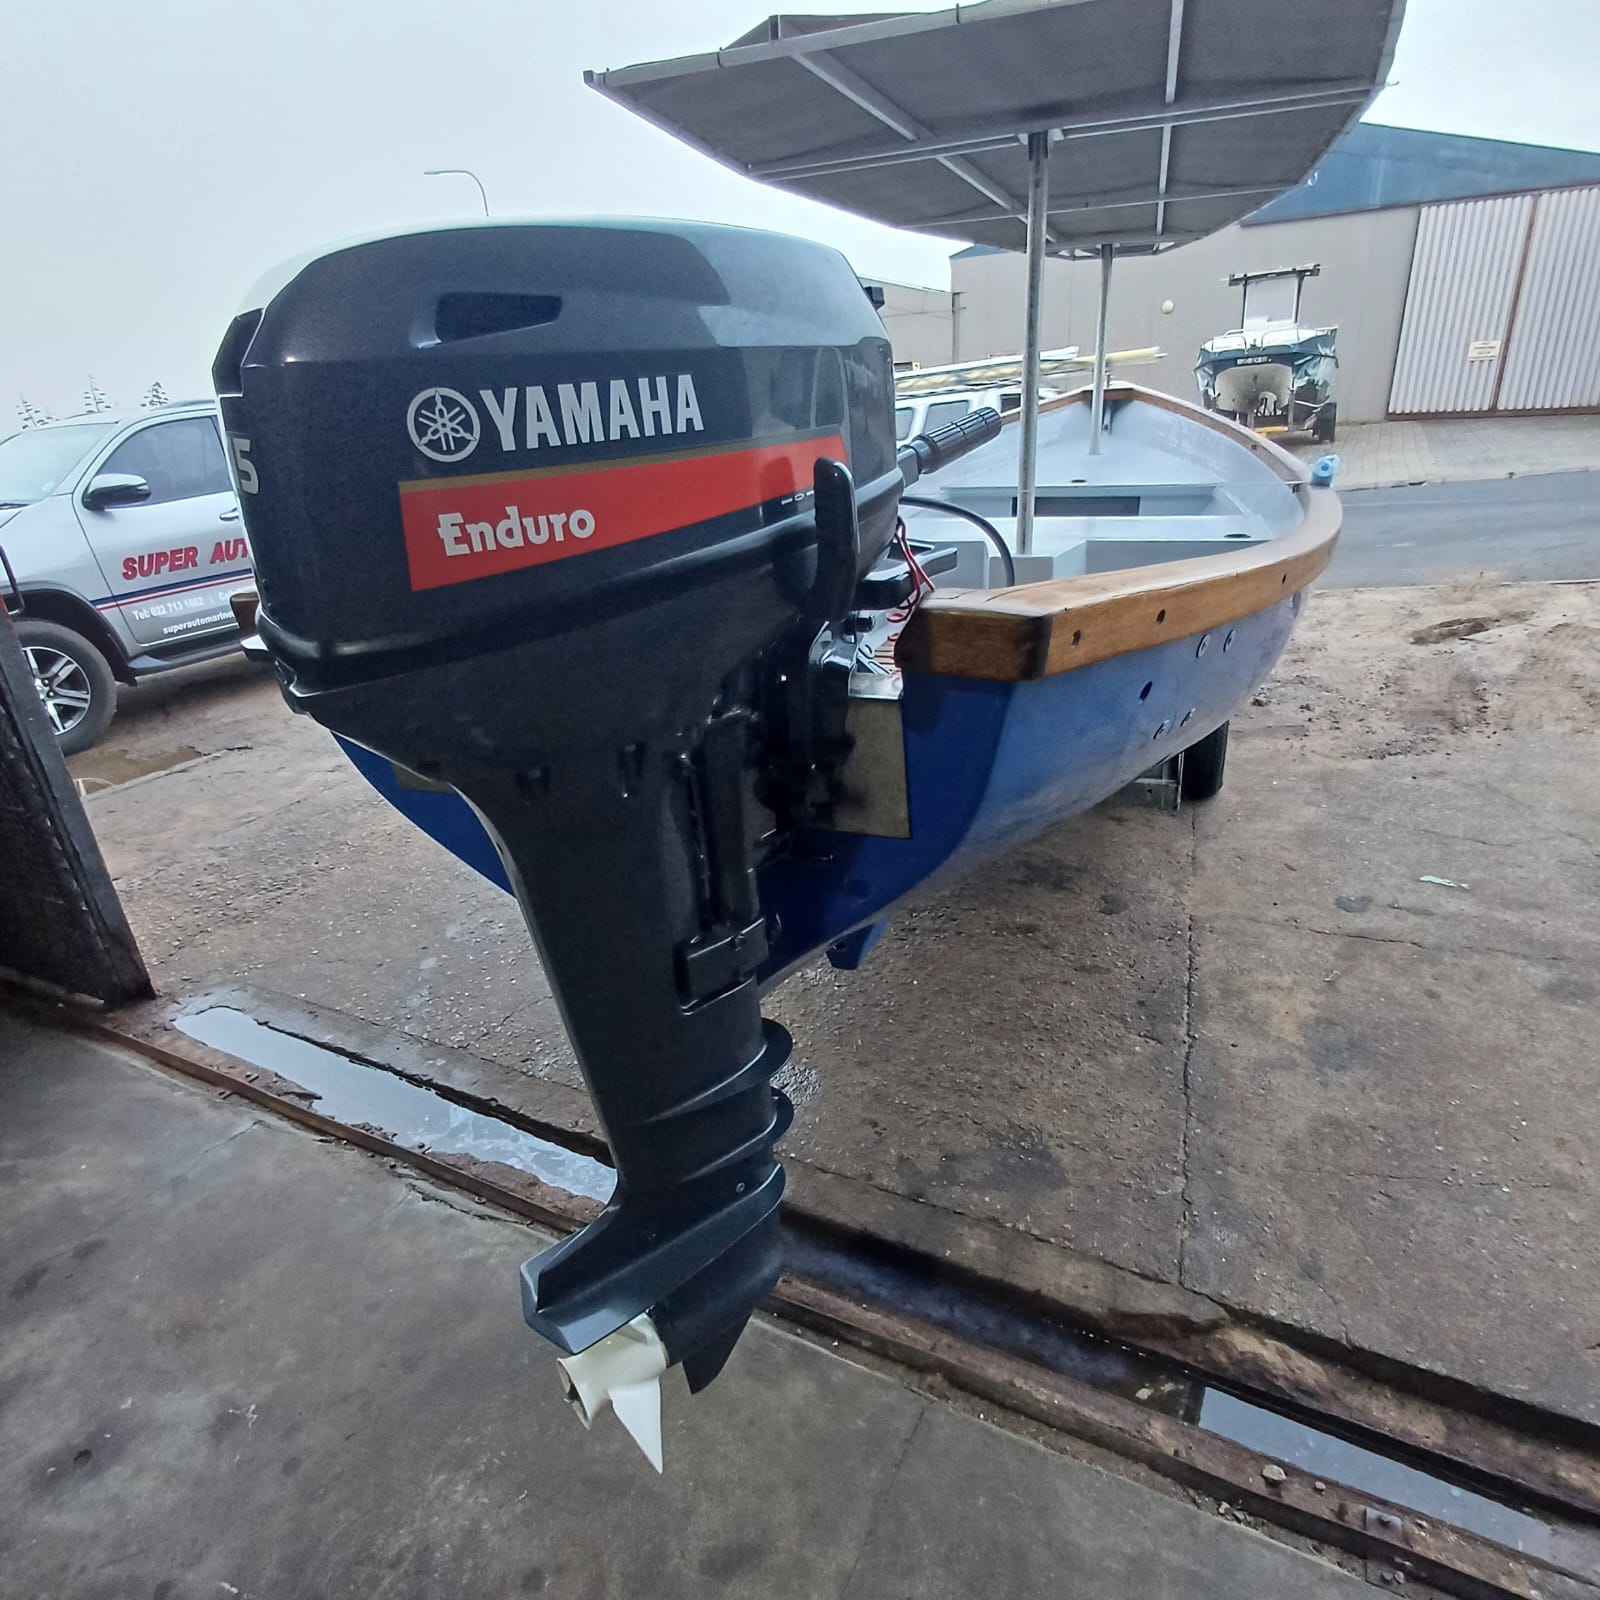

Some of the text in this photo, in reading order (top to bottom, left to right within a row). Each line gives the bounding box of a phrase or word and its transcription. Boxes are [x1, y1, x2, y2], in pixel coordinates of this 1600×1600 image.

[479, 374, 704, 451] YAMAHA
[437, 505, 596, 557] Enduro
[122, 546, 198, 581] SUPER
